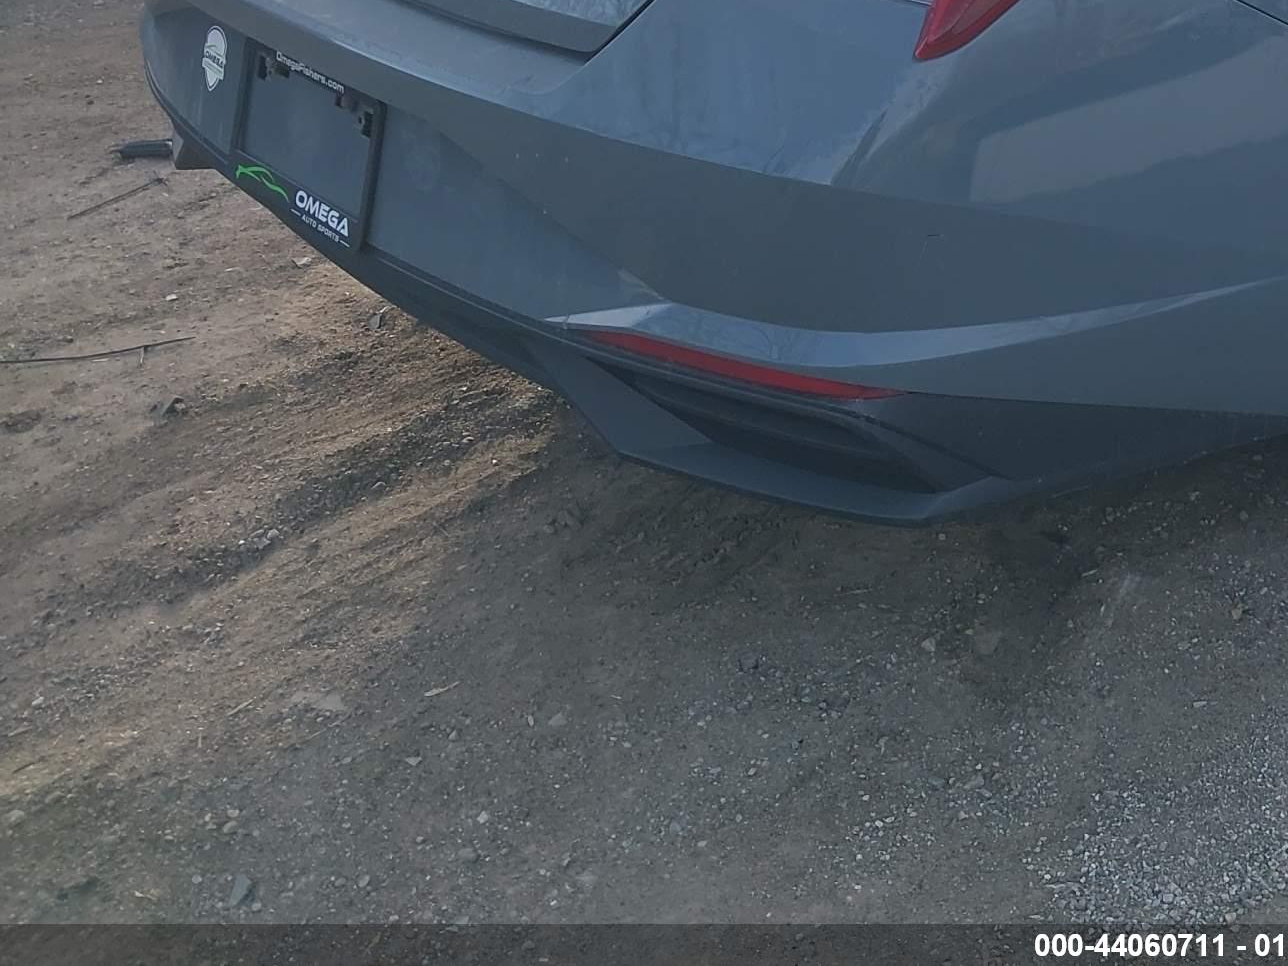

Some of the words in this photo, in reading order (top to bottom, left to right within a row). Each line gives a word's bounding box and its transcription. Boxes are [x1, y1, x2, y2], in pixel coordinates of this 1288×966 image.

[295, 190, 349, 238] OMEGA
[301, 214, 317, 228] AUTO
[317, 224, 339, 243] SPORTS
